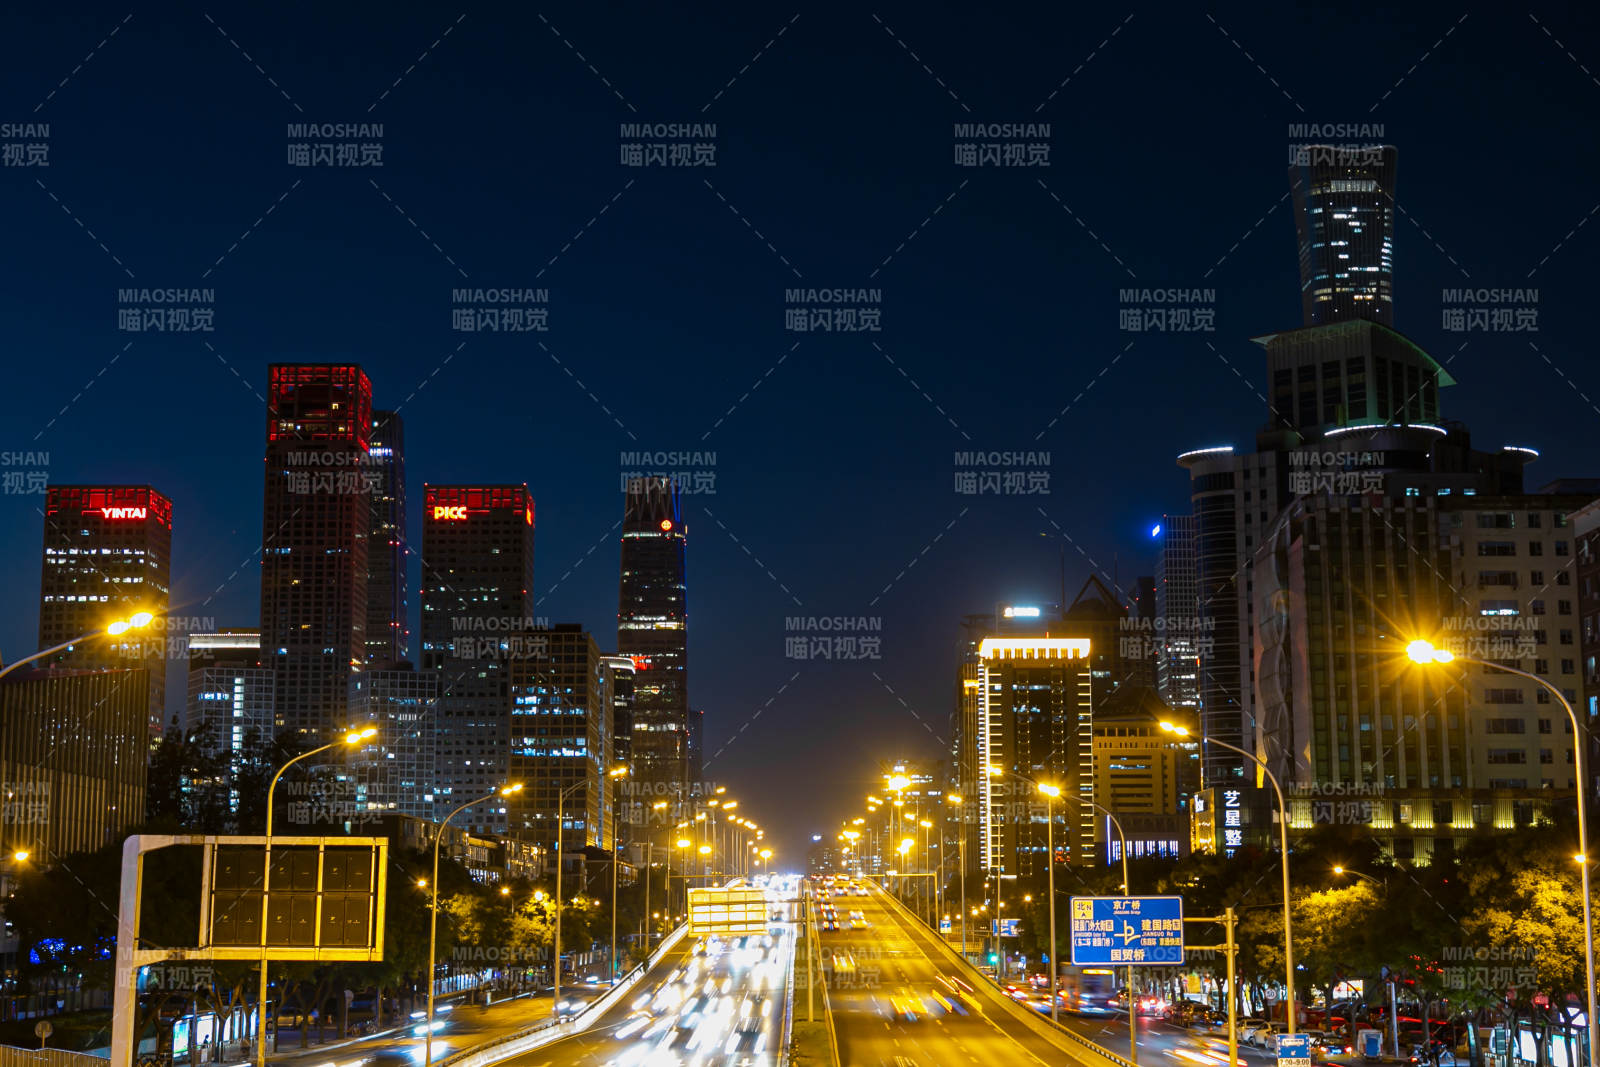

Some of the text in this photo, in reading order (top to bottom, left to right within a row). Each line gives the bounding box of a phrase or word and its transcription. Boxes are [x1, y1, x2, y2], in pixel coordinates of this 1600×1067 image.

[101, 507, 147, 519] YINTAI
[434, 506, 467, 519] PICC
[1112, 900, 1141, 910] 京广桥
[1111, 949, 1145, 961] 国贸桥
